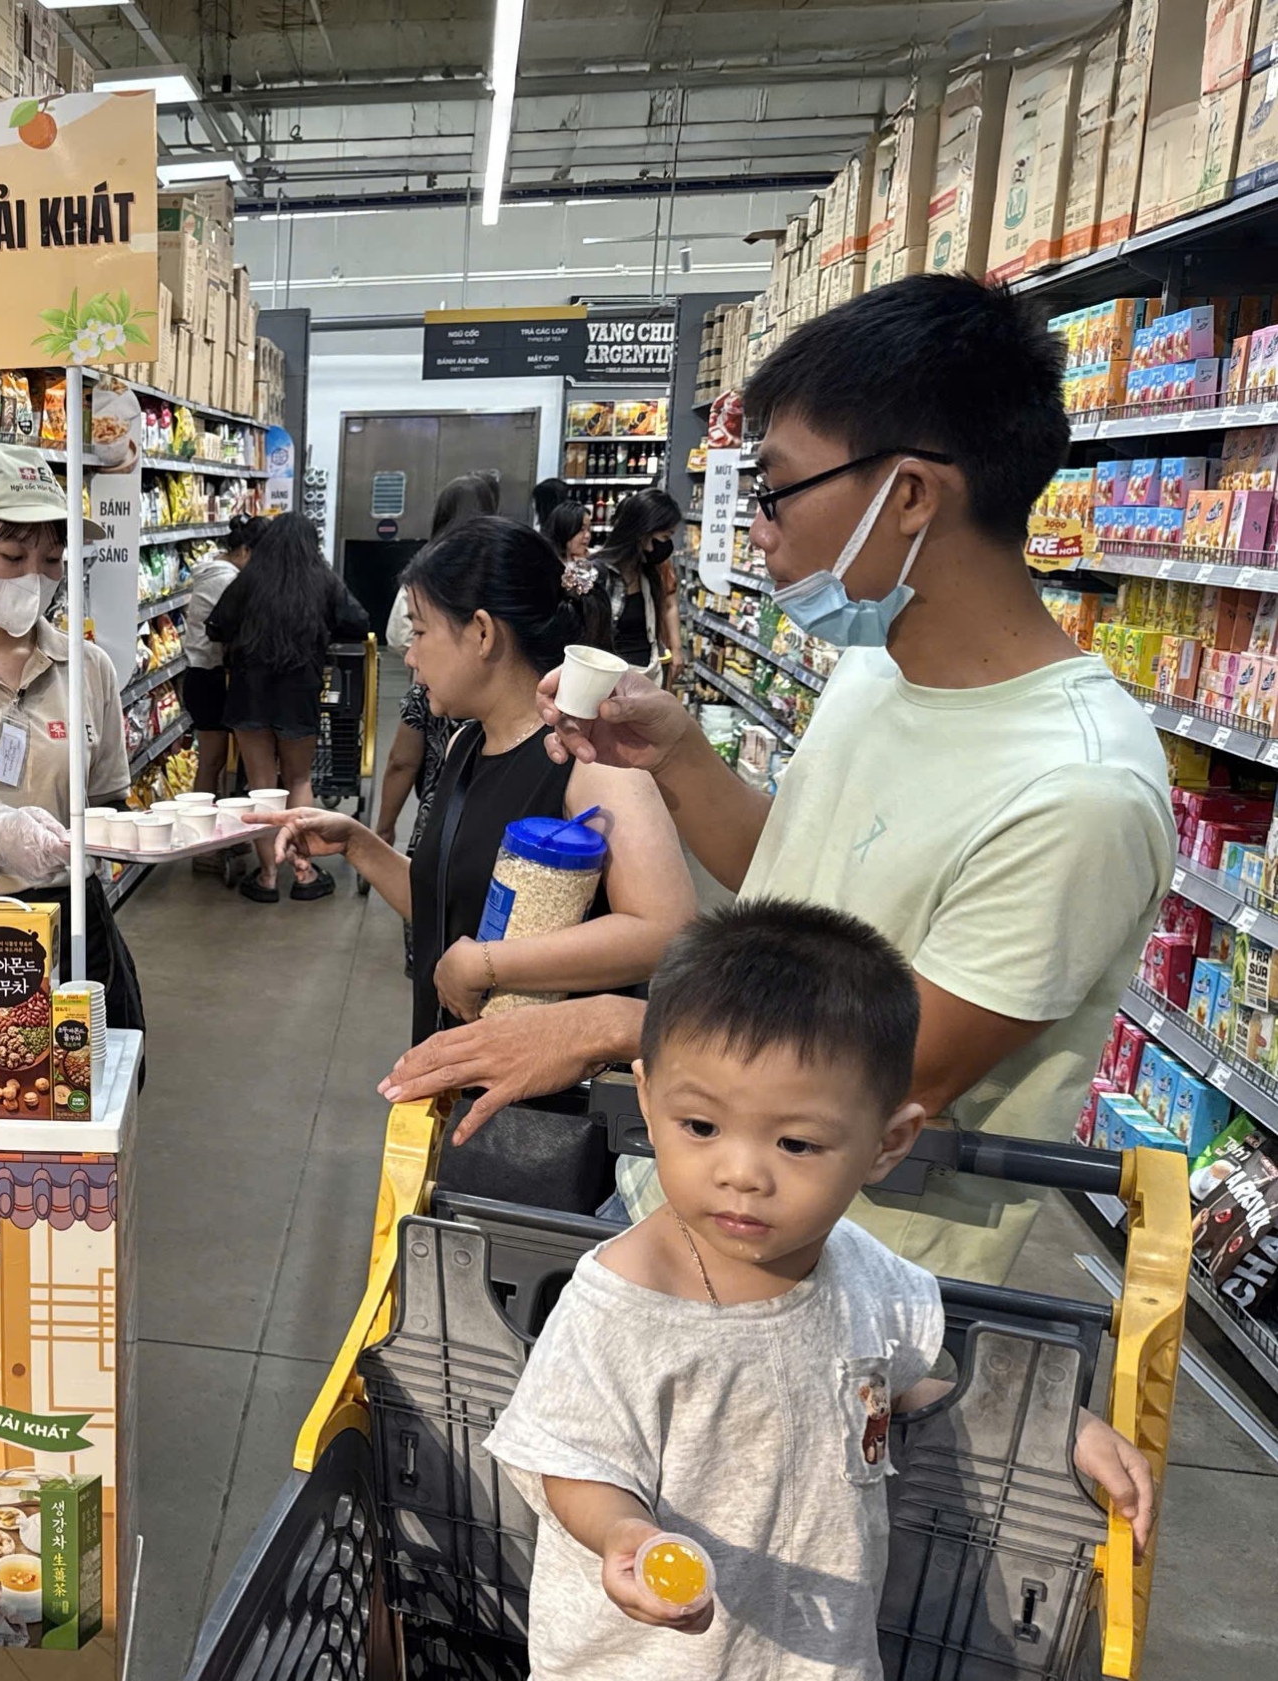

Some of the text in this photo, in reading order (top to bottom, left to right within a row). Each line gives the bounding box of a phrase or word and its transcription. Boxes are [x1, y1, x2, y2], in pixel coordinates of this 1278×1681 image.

[39, 181, 137, 249] KHÁT
[587, 323, 635, 342] VANG
[584, 344, 674, 364] ARGENTIN
[100, 501, 130, 517] BÁNH
[99, 546, 129, 562] SÁNG
[706, 552, 726, 562] MILO
[23, 1422, 71, 1440] KHÁT
[52, 1500, 67, 1549] 생강차
